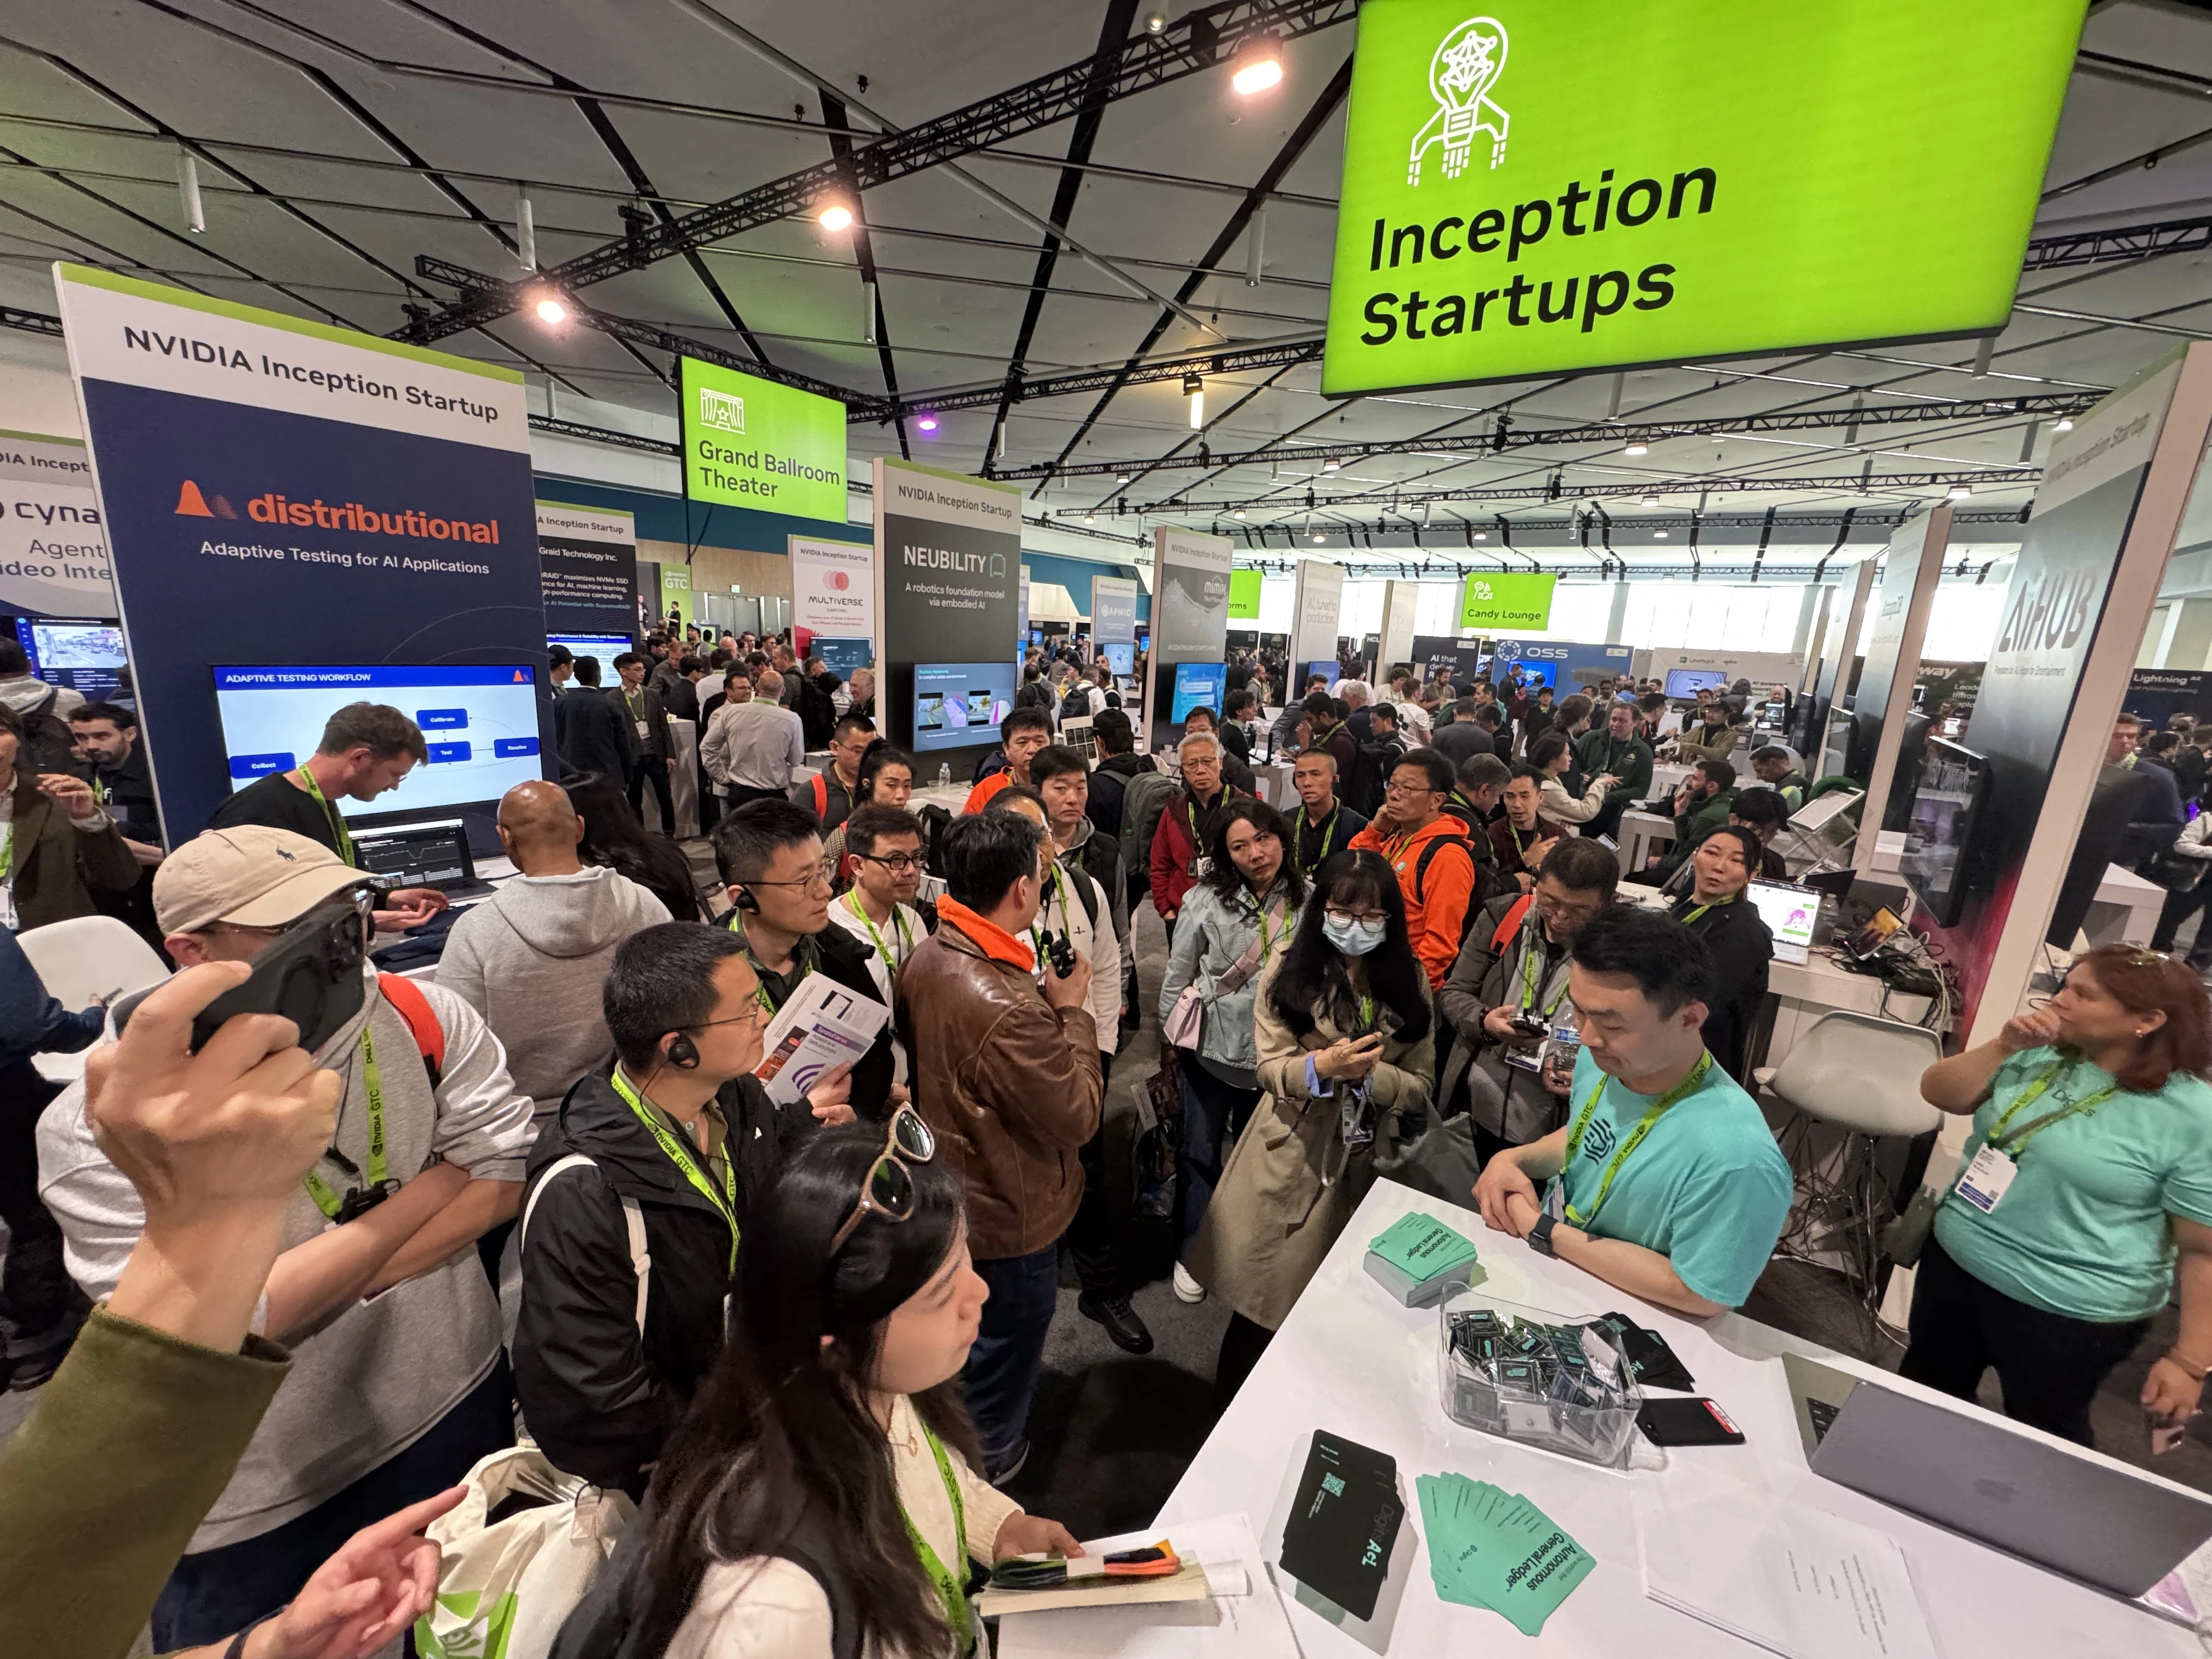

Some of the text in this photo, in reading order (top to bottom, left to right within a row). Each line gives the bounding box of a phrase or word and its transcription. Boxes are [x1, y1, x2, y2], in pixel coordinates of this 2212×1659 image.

[1369, 165, 1718, 273] Inception
[1359, 262, 1675, 346] Startups
[125, 326, 499, 424] NVIDIA Inception Startup
[31, 456, 90, 473] Incept
[699, 440, 840, 486] Grand Ballroom
[699, 467, 778, 498] Theater
[899, 485, 1012, 520] NVIDIA Inception Startup
[247, 494, 500, 545] distributional
[546, 517, 589, 529] Inception
[591, 523, 624, 534] Startup
[29, 539, 105, 559] Agent
[201, 541, 490, 575] Adaptive Testing for AI Applications
[539, 547, 618, 562] Graid Technology Inc.
[800, 548, 868, 562] NVIDIA Inception Startup
[904, 545, 986, 573] NEUBILITY
[664, 578, 689, 590] GTC
[905, 583, 1005, 599] A robotics foundation model
[809, 596, 864, 606] MULTIVERSE
[929, 598, 985, 610] via embodied AI
[1468, 609, 1541, 622] Candy Lounge
[1441, 655, 1458, 663] that
[1526, 647, 1569, 659] OSS
[226, 673, 371, 683] ADAPTIVE TESTING WORKFLOW
[2133, 674, 2188, 686] Lightning
[370, 1089, 381, 1111] GTC
[1582, 1104, 1593, 1121] GTC
[676, 1155, 694, 1175] GTC
[1611, 1154, 1624, 1172] GTC
[1531, 1532, 1565, 1566] General
[1526, 1543, 1577, 1592] Autonomous
